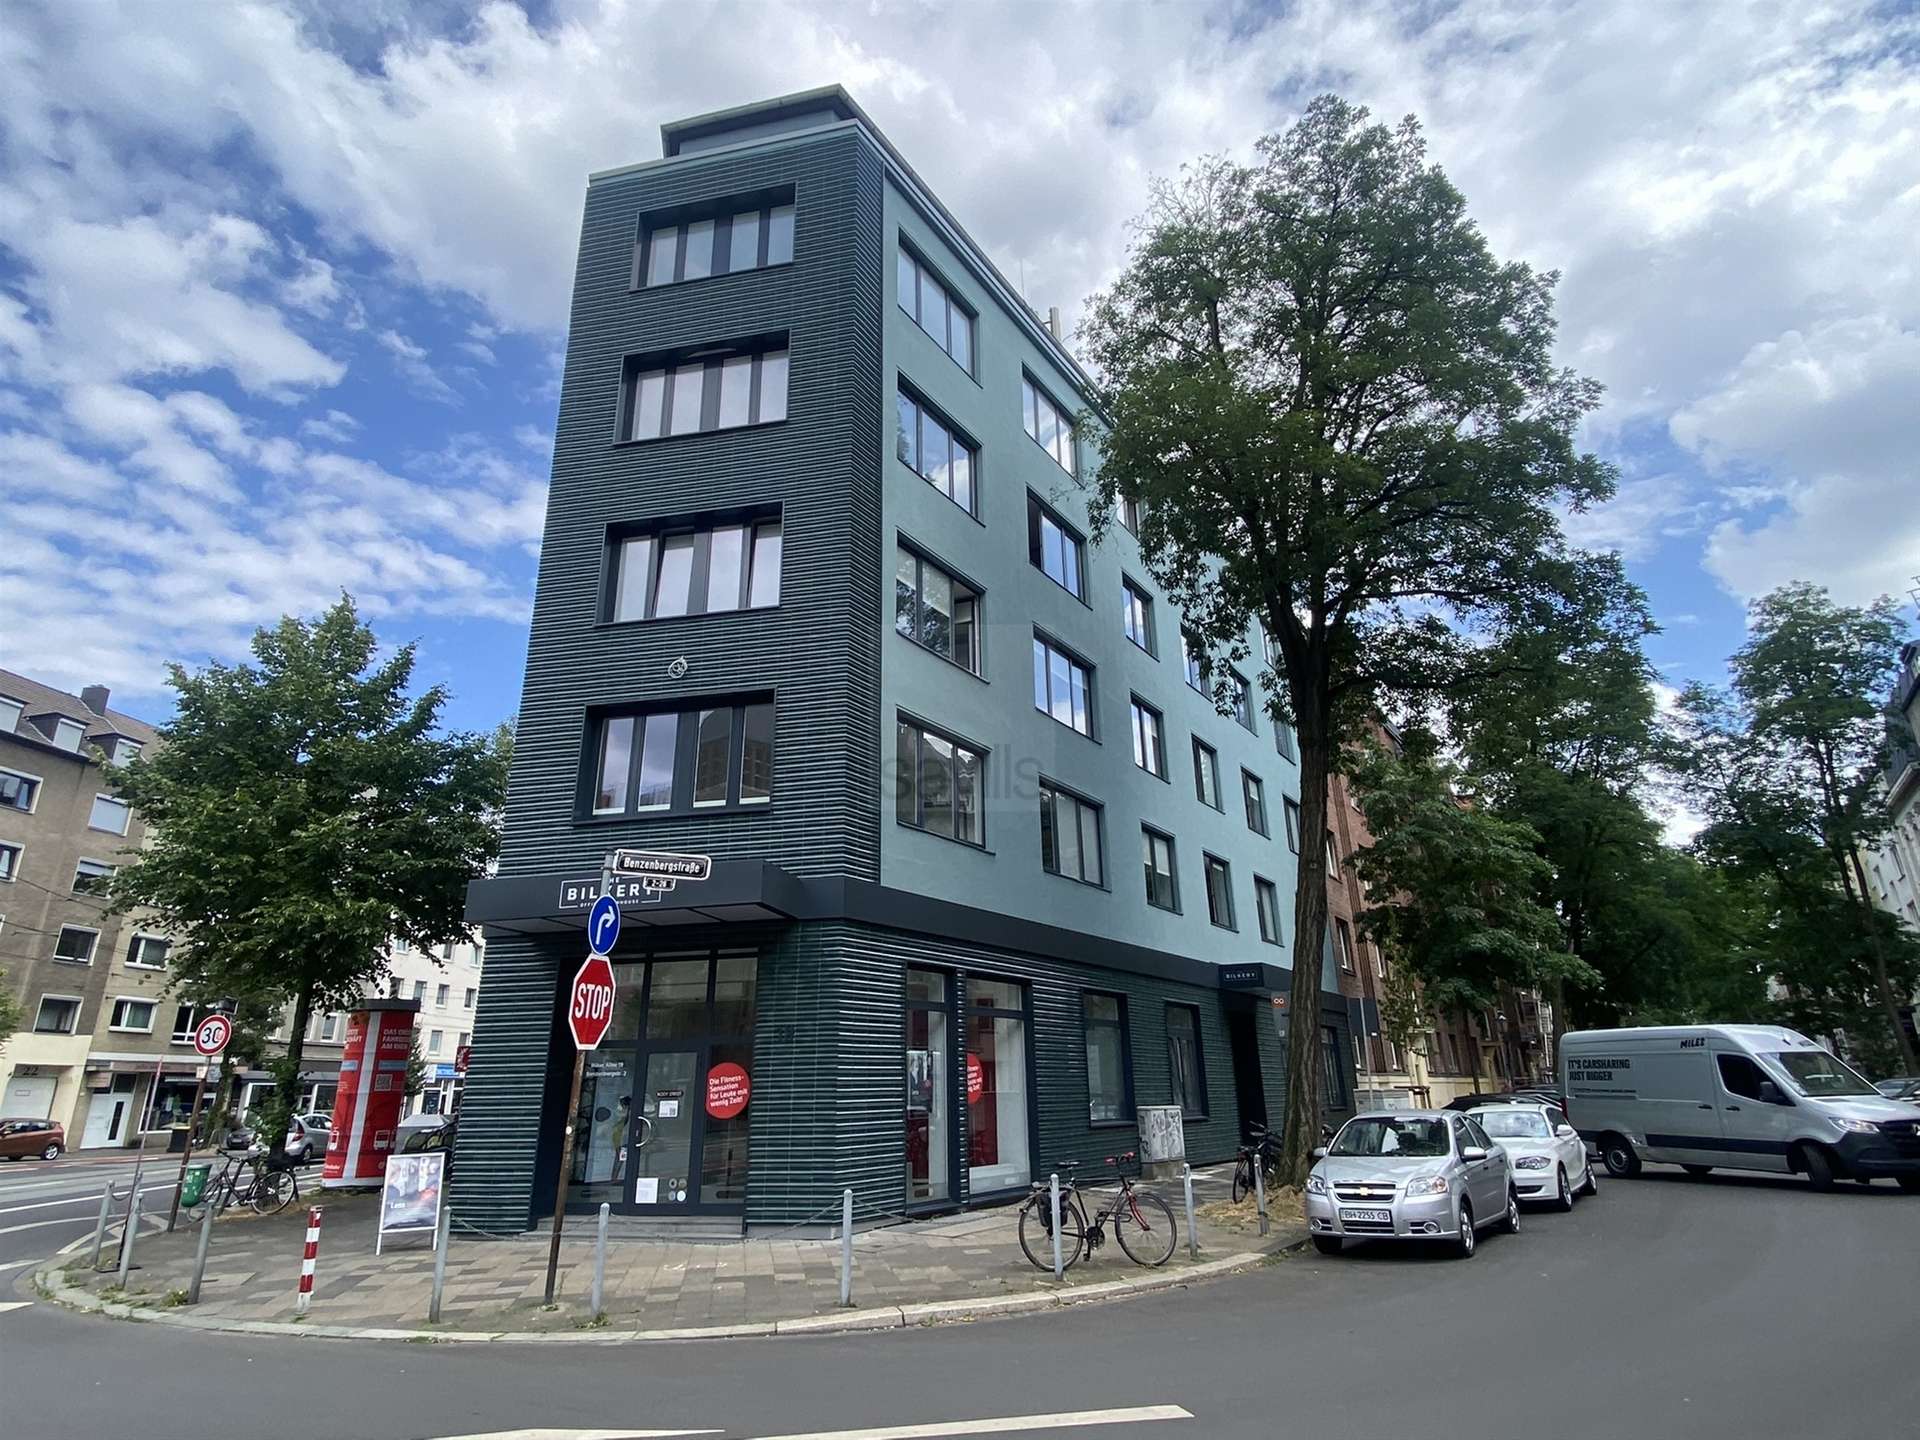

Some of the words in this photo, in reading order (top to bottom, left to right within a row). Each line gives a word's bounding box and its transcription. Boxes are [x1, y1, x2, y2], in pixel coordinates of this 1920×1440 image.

[623, 857, 701, 874] Benzenbergstraße
[574, 982, 611, 1020] STOP
[1582, 1059, 1630, 1069] CARSHARING
[709, 1078, 720, 1086] Die
[720, 1075, 744, 1084] Fitness-
[1569, 1071, 1585, 1080] JUST
[1586, 1071, 1613, 1080] BIGGER
[709, 1083, 739, 1092] Sensation
[710, 1092, 719, 1100] für
[719, 1090, 737, 1098] Leute
[710, 1099, 729, 1107] wenig
